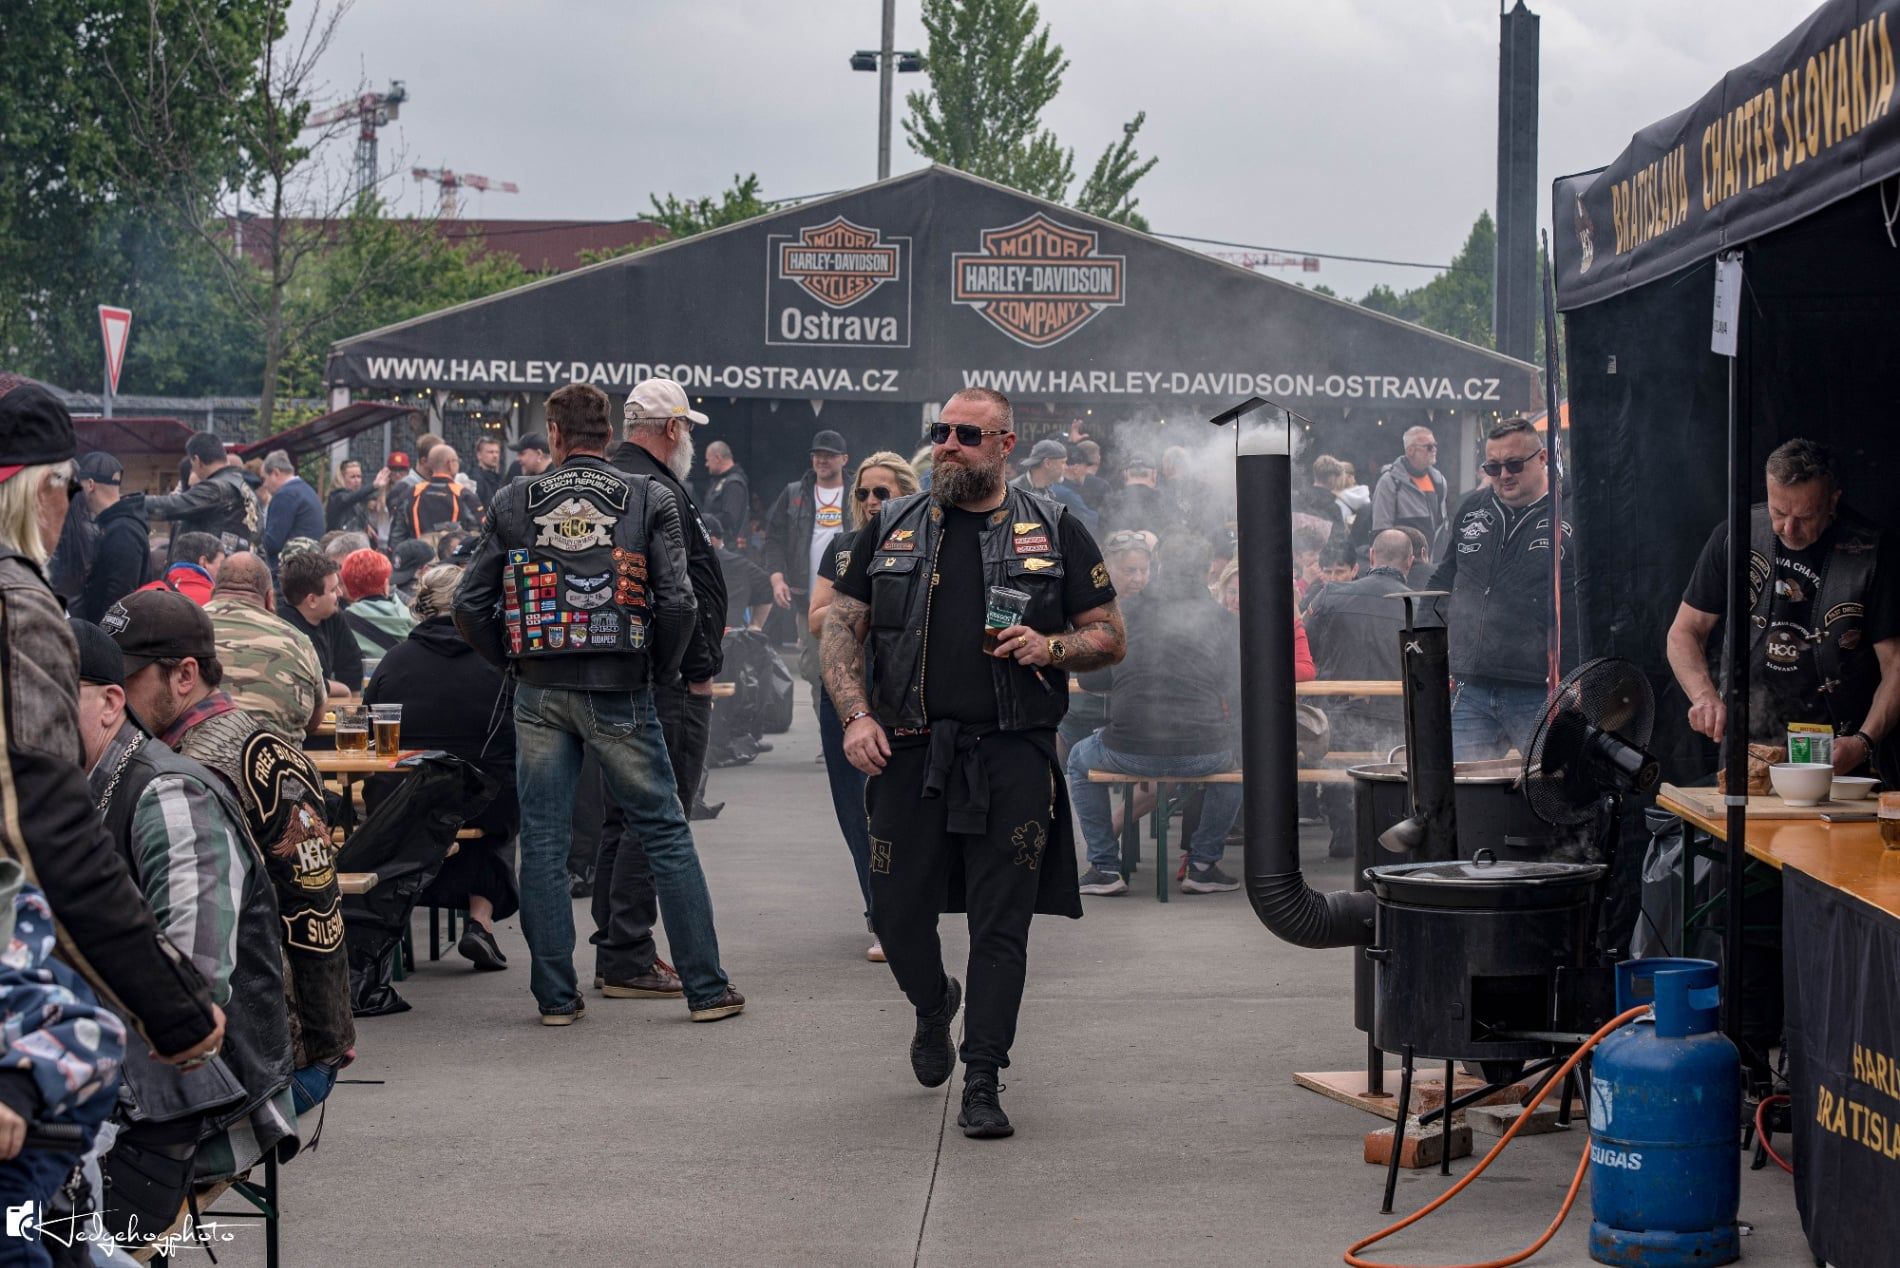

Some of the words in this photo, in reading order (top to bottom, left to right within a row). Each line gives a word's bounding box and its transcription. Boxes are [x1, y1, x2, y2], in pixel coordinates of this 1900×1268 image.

[1610, 144, 1689, 256] BRATISLAVA
[1702, 87, 1778, 212] CHAPTER
[1780, 12, 1897, 171] SLOVAKIA
[814, 227, 866, 248] MOTOR
[1001, 227, 1079, 257] MOTOR
[790, 252, 889, 272] HARLEY-DAVIDSON
[813, 276, 865, 300] CYCLES
[965, 265, 1113, 293] HARLEY-DAVIDSON
[781, 307, 898, 342] Ostrava
[1000, 301, 1079, 336] COMPANY
[366, 357, 899, 392] WWW.HARLEY-DAVIDSON-OSTRAVA.CZ
[962, 369, 1502, 400] WWW.HARLEY-DAVIDSON-OSTRAVA.CZ
[540, 471, 578, 487] OSTRAVA
[582, 471, 620, 488] CHAPTER
[543, 479, 573, 493] CZECH
[575, 477, 614, 494] REPUBLIC
[255, 746, 276, 788] FREE
